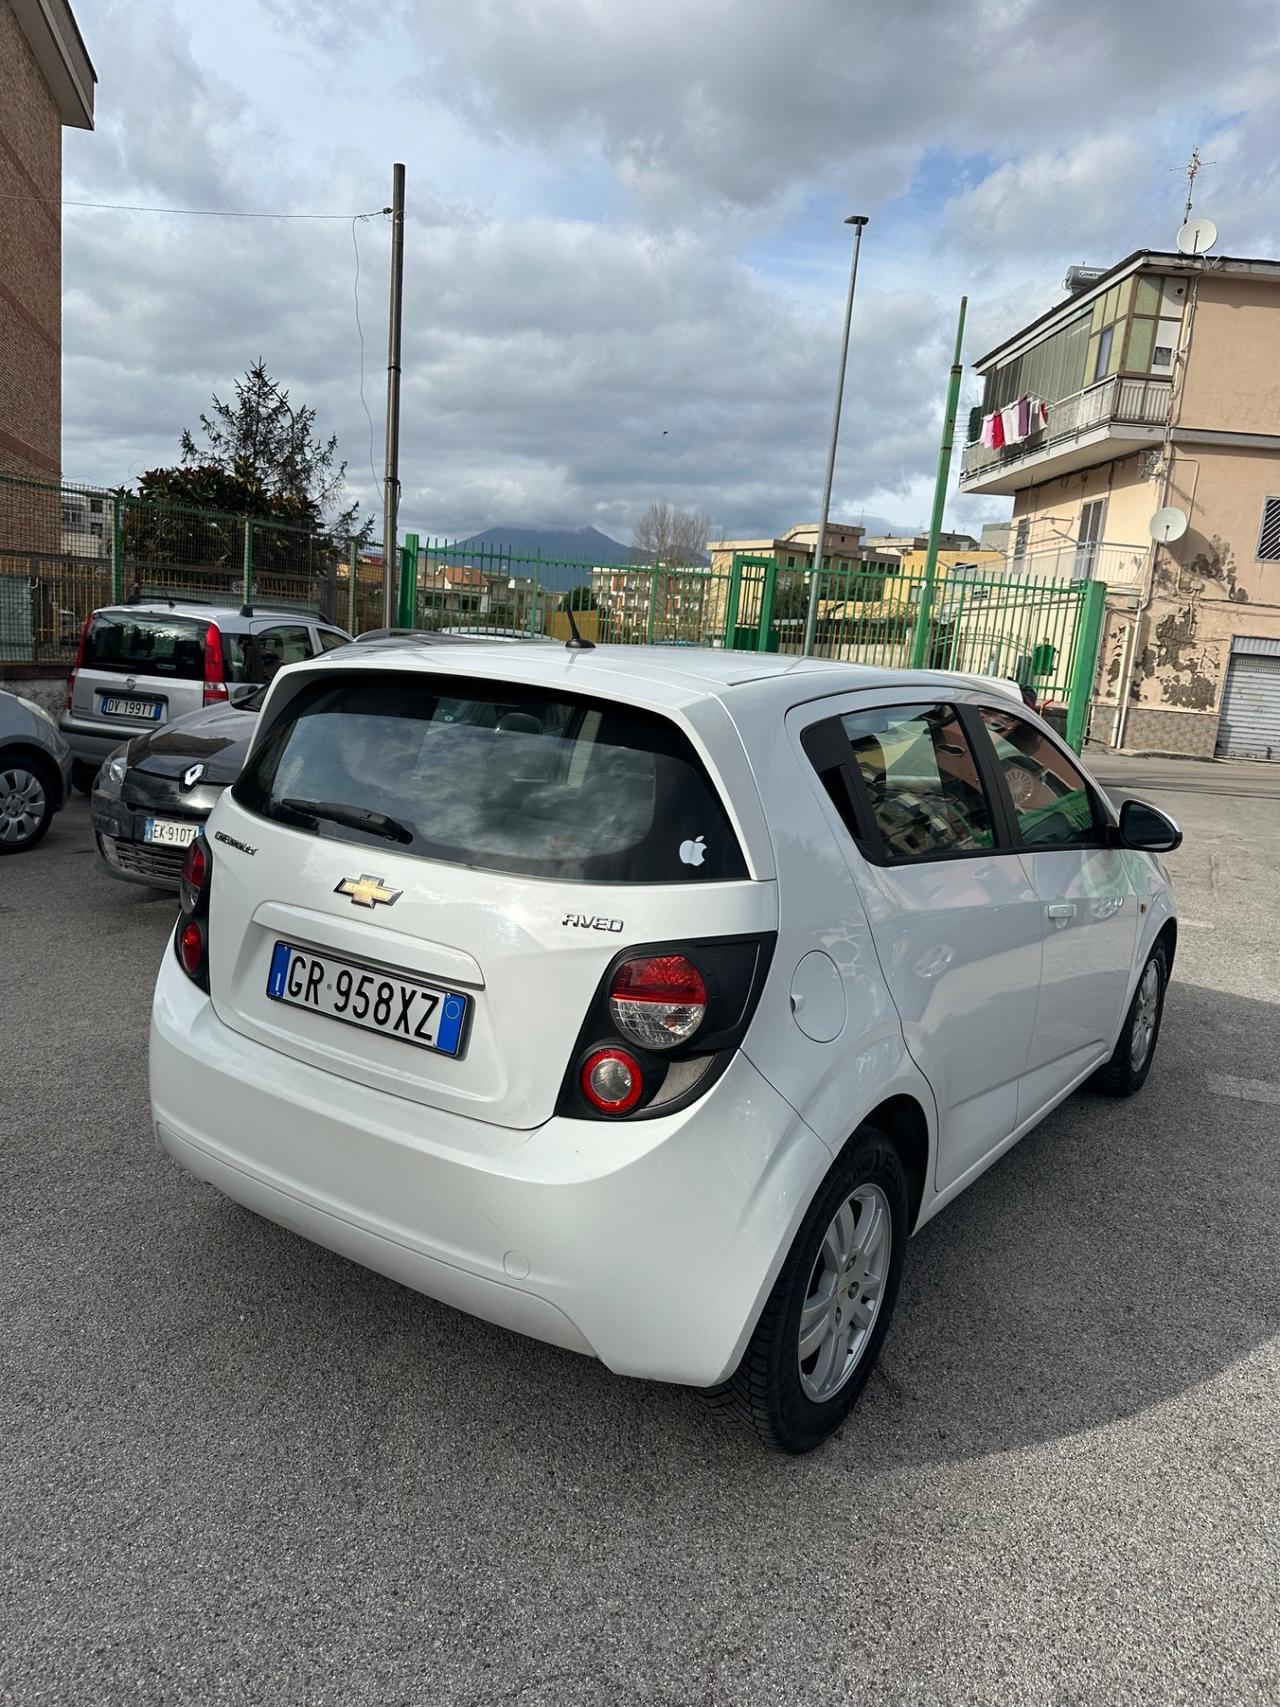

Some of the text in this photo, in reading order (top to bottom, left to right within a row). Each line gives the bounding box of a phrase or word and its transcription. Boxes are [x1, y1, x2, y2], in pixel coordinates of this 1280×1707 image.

[153, 824, 166, 840] EK
[562, 914, 624, 933] AVEO
[287, 955, 325, 1006] GR
[333, 969, 440, 1041] 958XZ
